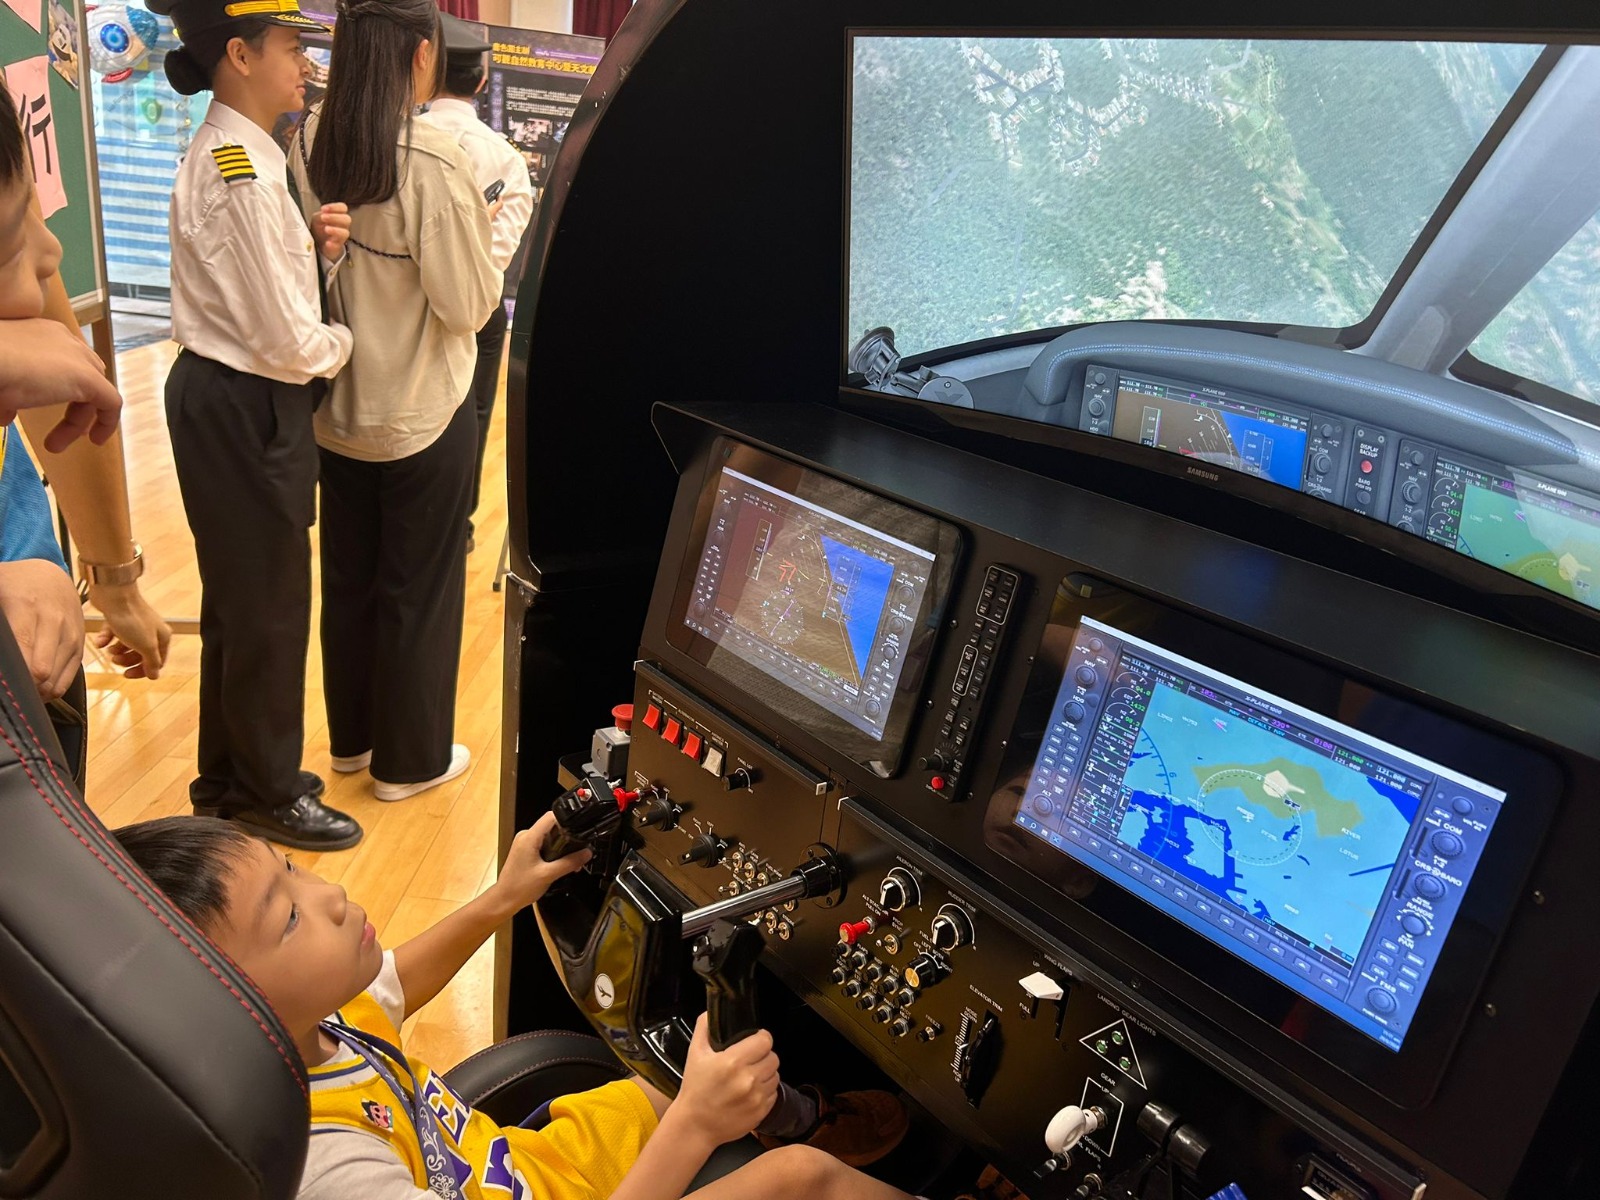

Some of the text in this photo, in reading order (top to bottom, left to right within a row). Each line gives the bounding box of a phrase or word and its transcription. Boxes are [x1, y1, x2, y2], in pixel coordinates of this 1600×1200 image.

[1360, 449, 1378, 457] BACKUP
[1361, 443, 1378, 452] DISPLAY
[1187, 467, 1219, 481] SAMSUNG
[1073, 695, 1085, 704] HDG
[1245, 696, 1282, 714] X-PLANE 1000
[1341, 828, 1361, 840] RIVER
[1443, 823, 1463, 835] COM
[1339, 847, 1358, 860] LOTUS
[948, 890, 976, 912] RUDDER TRIM
[1406, 902, 1434, 920] RANGE
[921, 941, 931, 950] LEFT
[1398, 937, 1414, 950] PAN
[941, 962, 953, 973] RIGHT
[1044, 954, 1073, 976] WING FLAPS
[1380, 980, 1396, 993] FMS
[970, 984, 1003, 1012] ELEVATOR TRIM
[965, 1006, 978, 1018] NOSE
[1019, 1002, 1031, 1014] FULL
[1097, 993, 1156, 1036] LANDING GEAR LIGHTS
[925, 1014, 940, 1028] FREEZE
[1100, 1072, 1116, 1086] GEAR
[1084, 1136, 1101, 1150] DOWN
